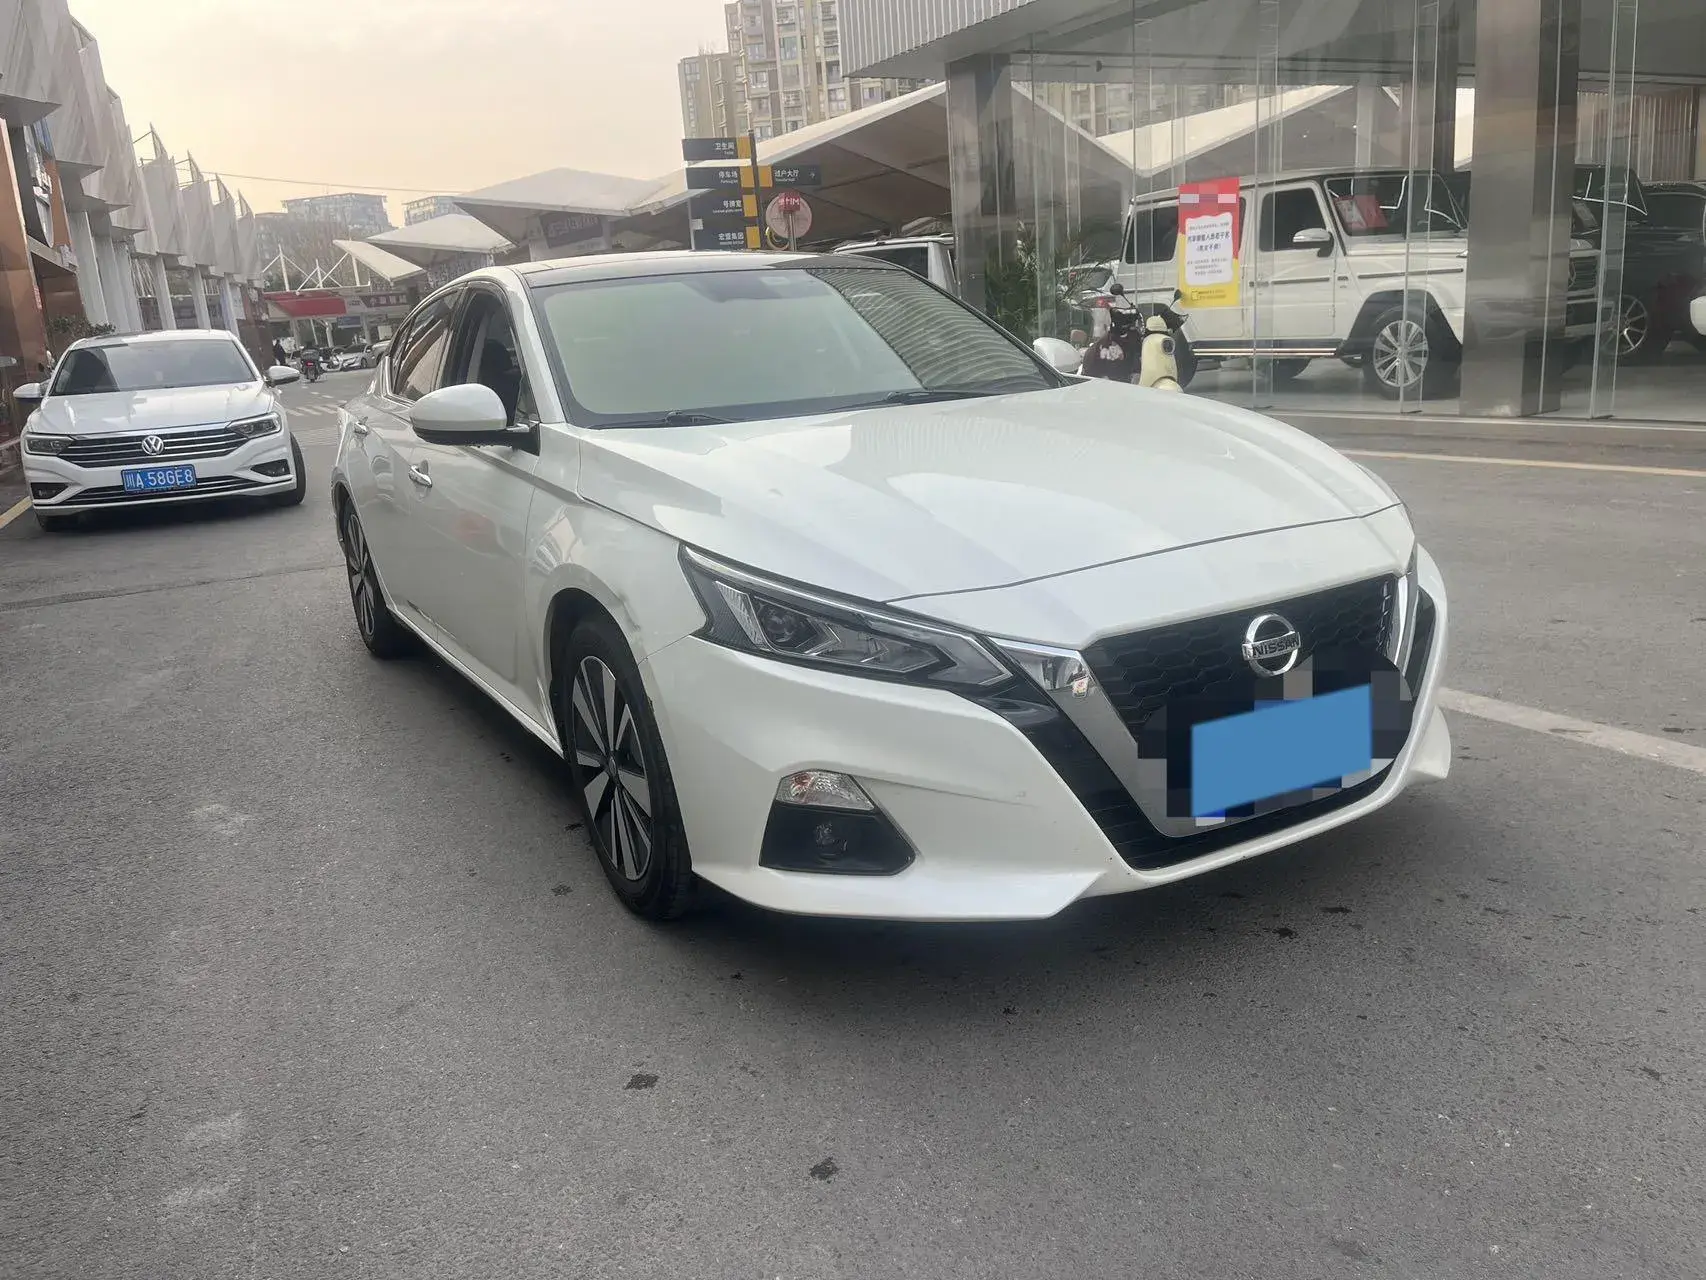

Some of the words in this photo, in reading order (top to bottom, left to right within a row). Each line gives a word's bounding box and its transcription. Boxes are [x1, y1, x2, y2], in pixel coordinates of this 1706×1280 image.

[714, 142, 735, 150] 卫生间
[718, 171, 738, 179] 停车场
[774, 169, 800, 177] 过户大厅
[1252, 633, 1298, 656] NISSAN
